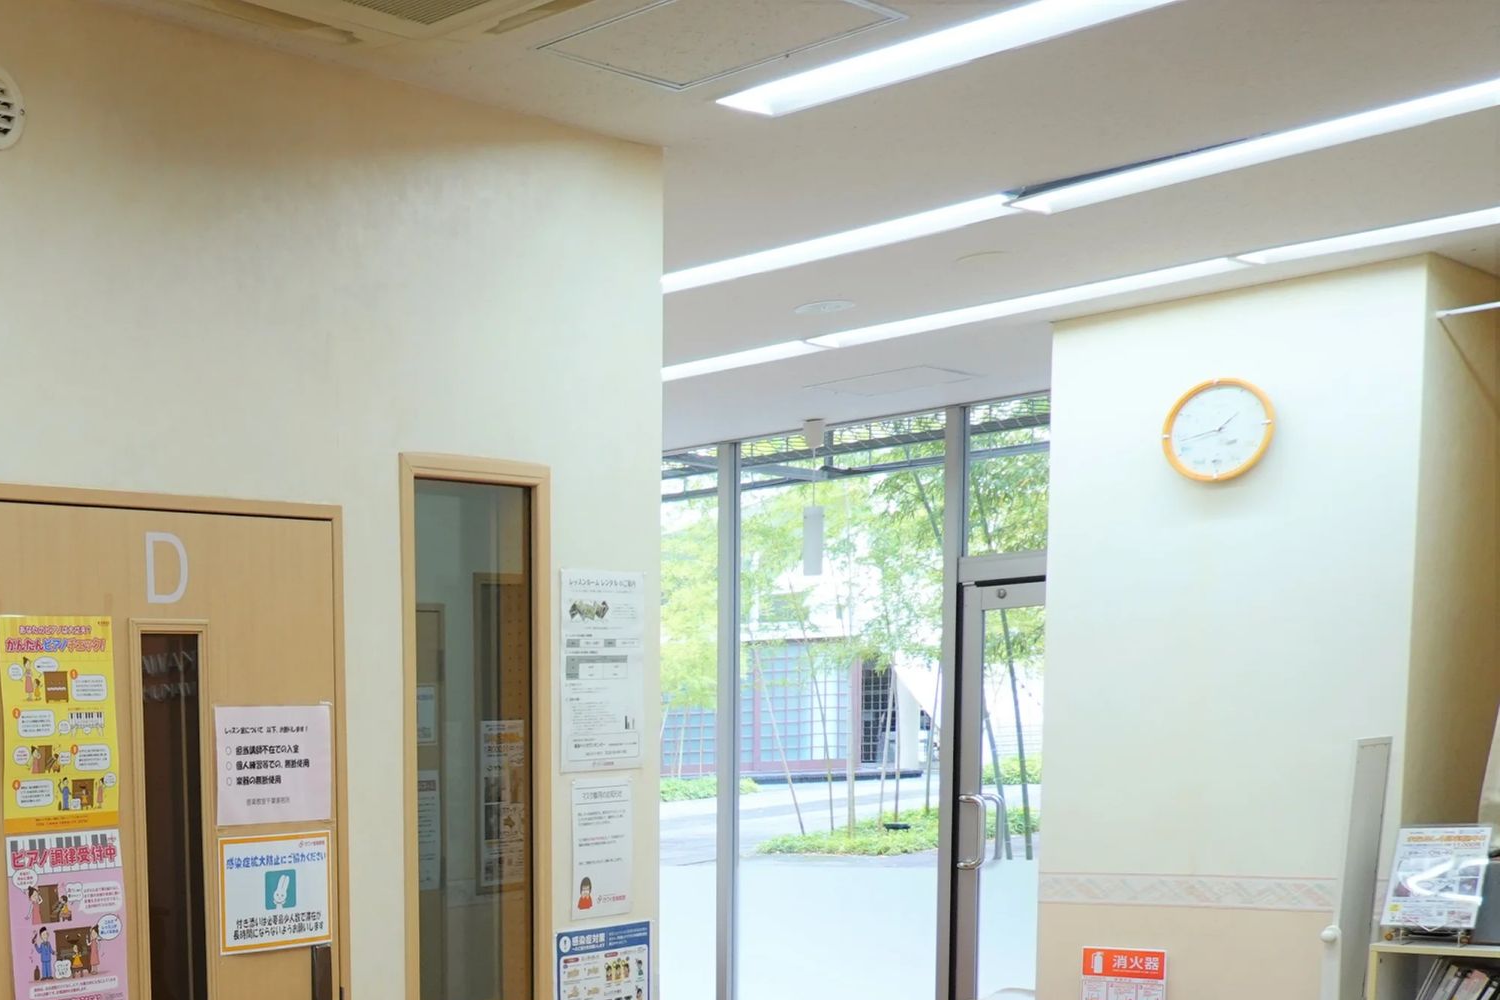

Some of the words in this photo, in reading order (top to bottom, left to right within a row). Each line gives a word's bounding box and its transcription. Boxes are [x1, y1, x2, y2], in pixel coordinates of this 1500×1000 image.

[146, 531, 188, 603] D
[11, 844, 117, 869] ピアノ調律受付中
[1112, 954, 1160, 971] 消火器
